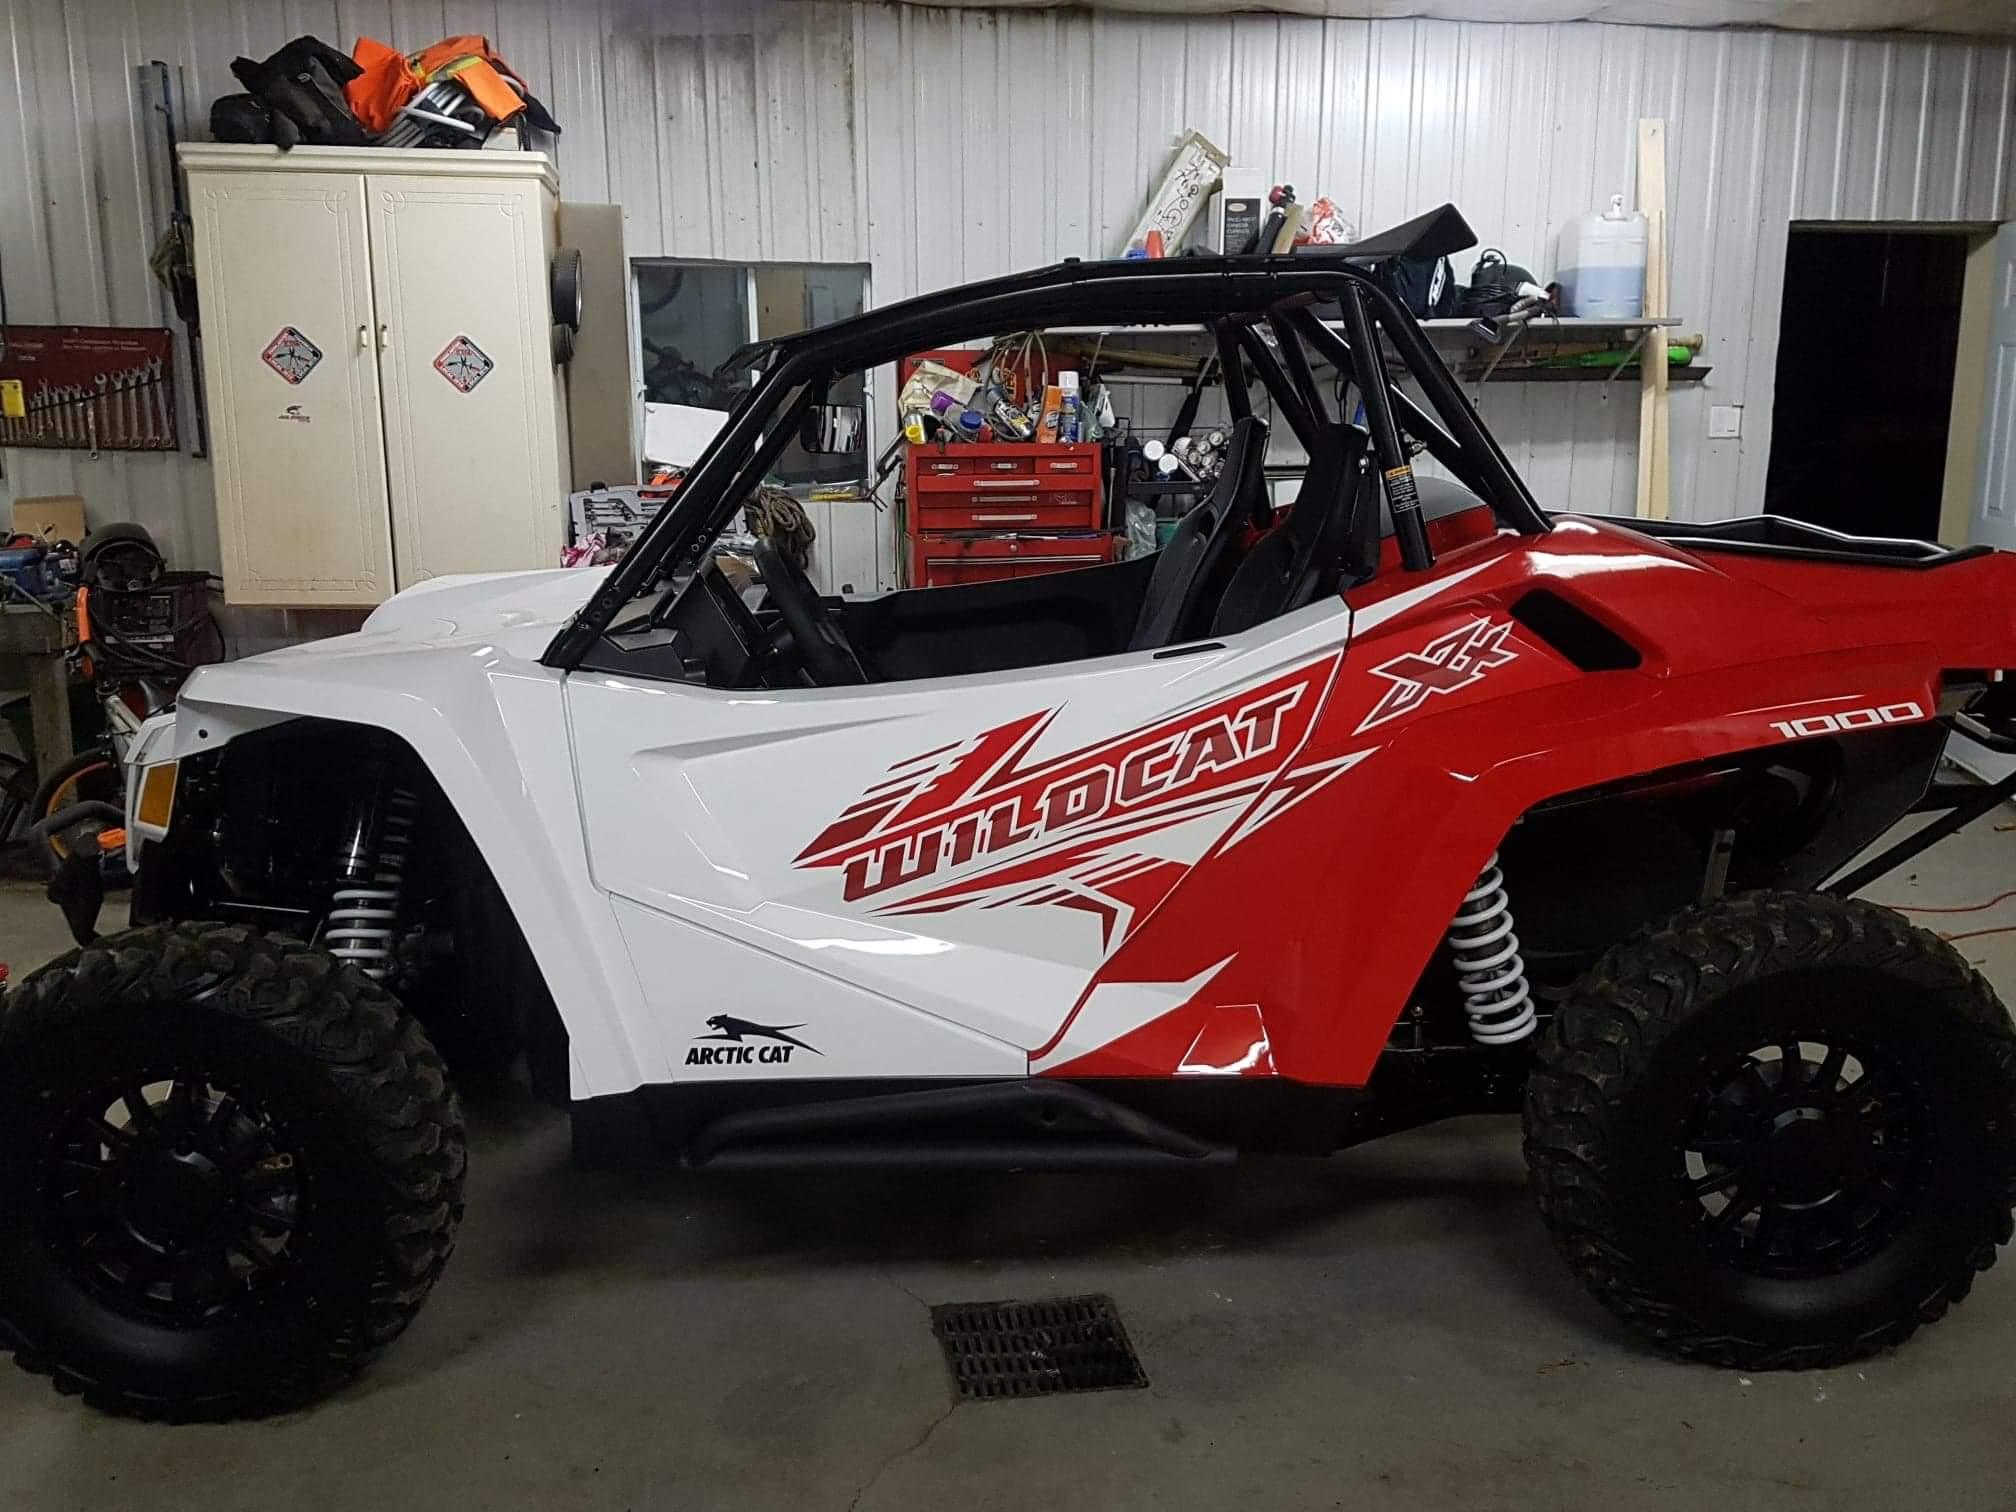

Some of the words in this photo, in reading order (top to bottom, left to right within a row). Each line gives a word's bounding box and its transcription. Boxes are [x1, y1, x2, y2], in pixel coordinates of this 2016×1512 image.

[1769, 702, 1925, 738] 1000
[841, 681, 1309, 903] WILDCAT
[685, 1046, 755, 1065] ARCTIC
[758, 1045, 795, 1064] CAT
